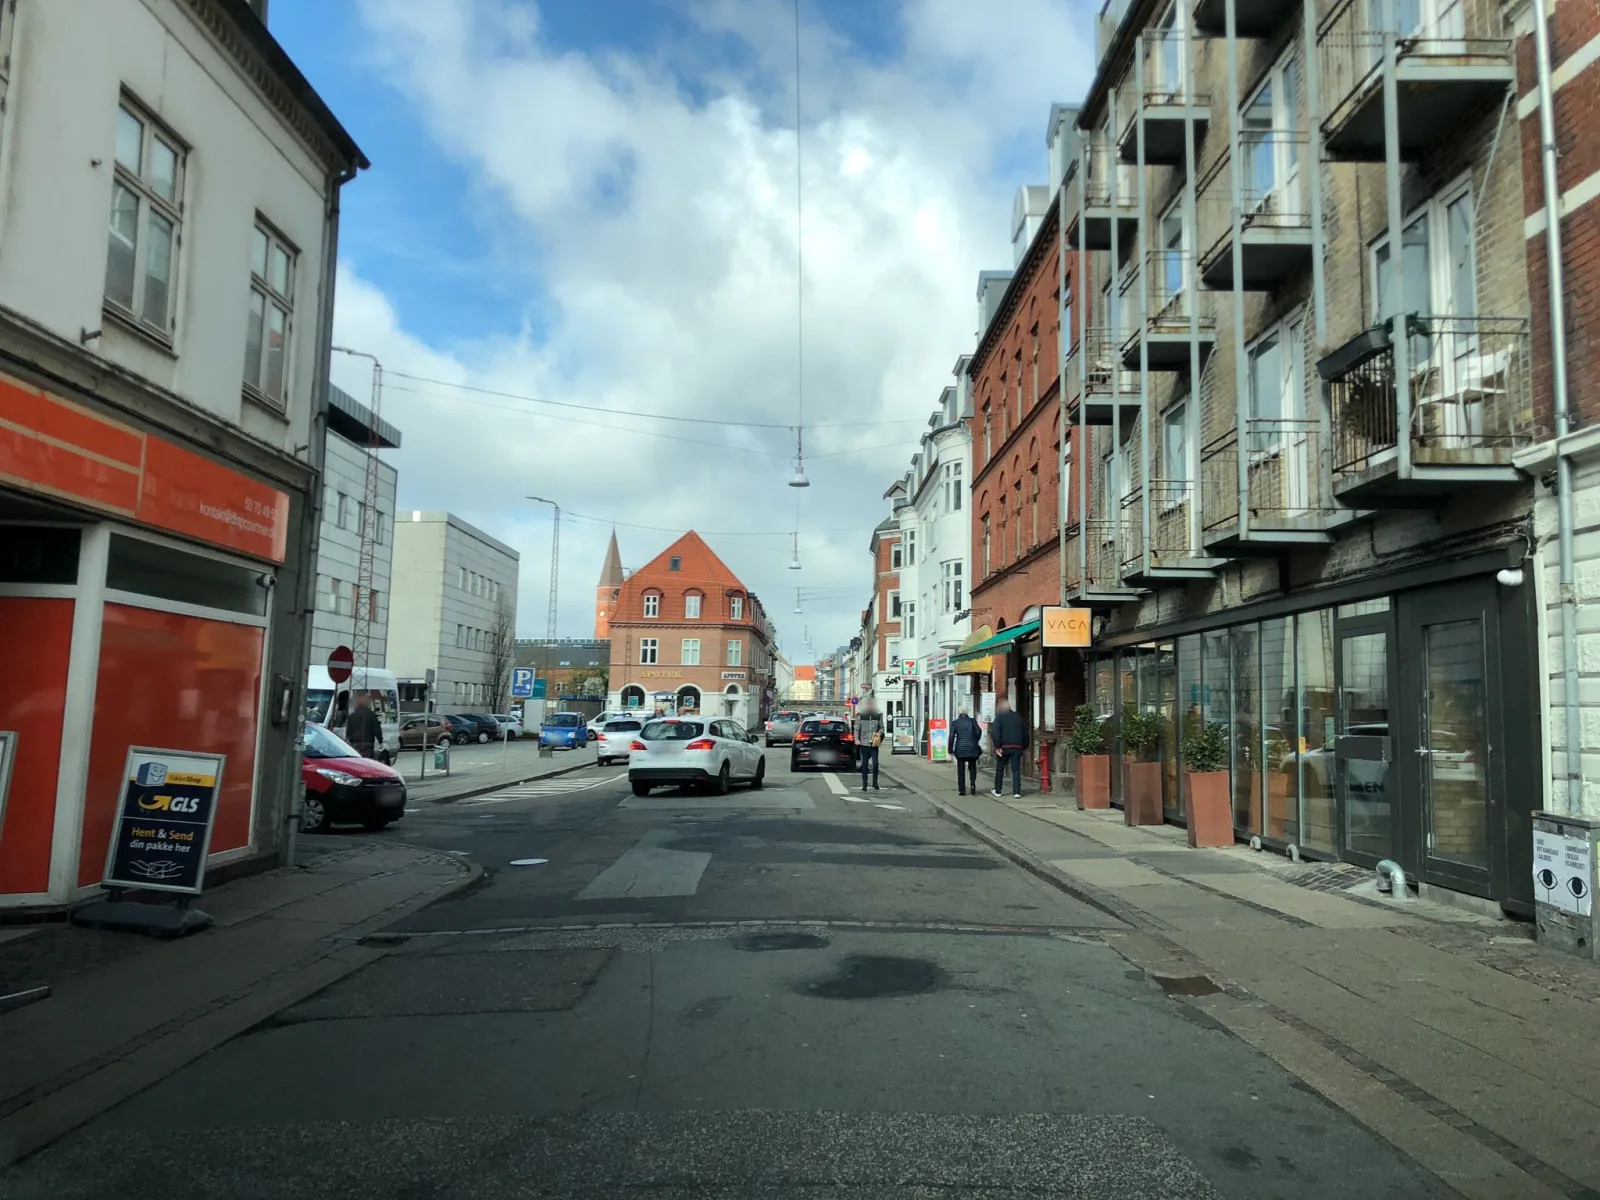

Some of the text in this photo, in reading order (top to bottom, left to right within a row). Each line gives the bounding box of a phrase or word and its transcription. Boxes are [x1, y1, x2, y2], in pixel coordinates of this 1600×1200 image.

[1048, 620, 1087, 630] VACA
[515, 670, 531, 686] P
[640, 670, 682, 680] APOTEK
[170, 797, 200, 812] GLS
[132, 828, 194, 840] Hent & Send
[130, 840, 191, 853] din pakke her
